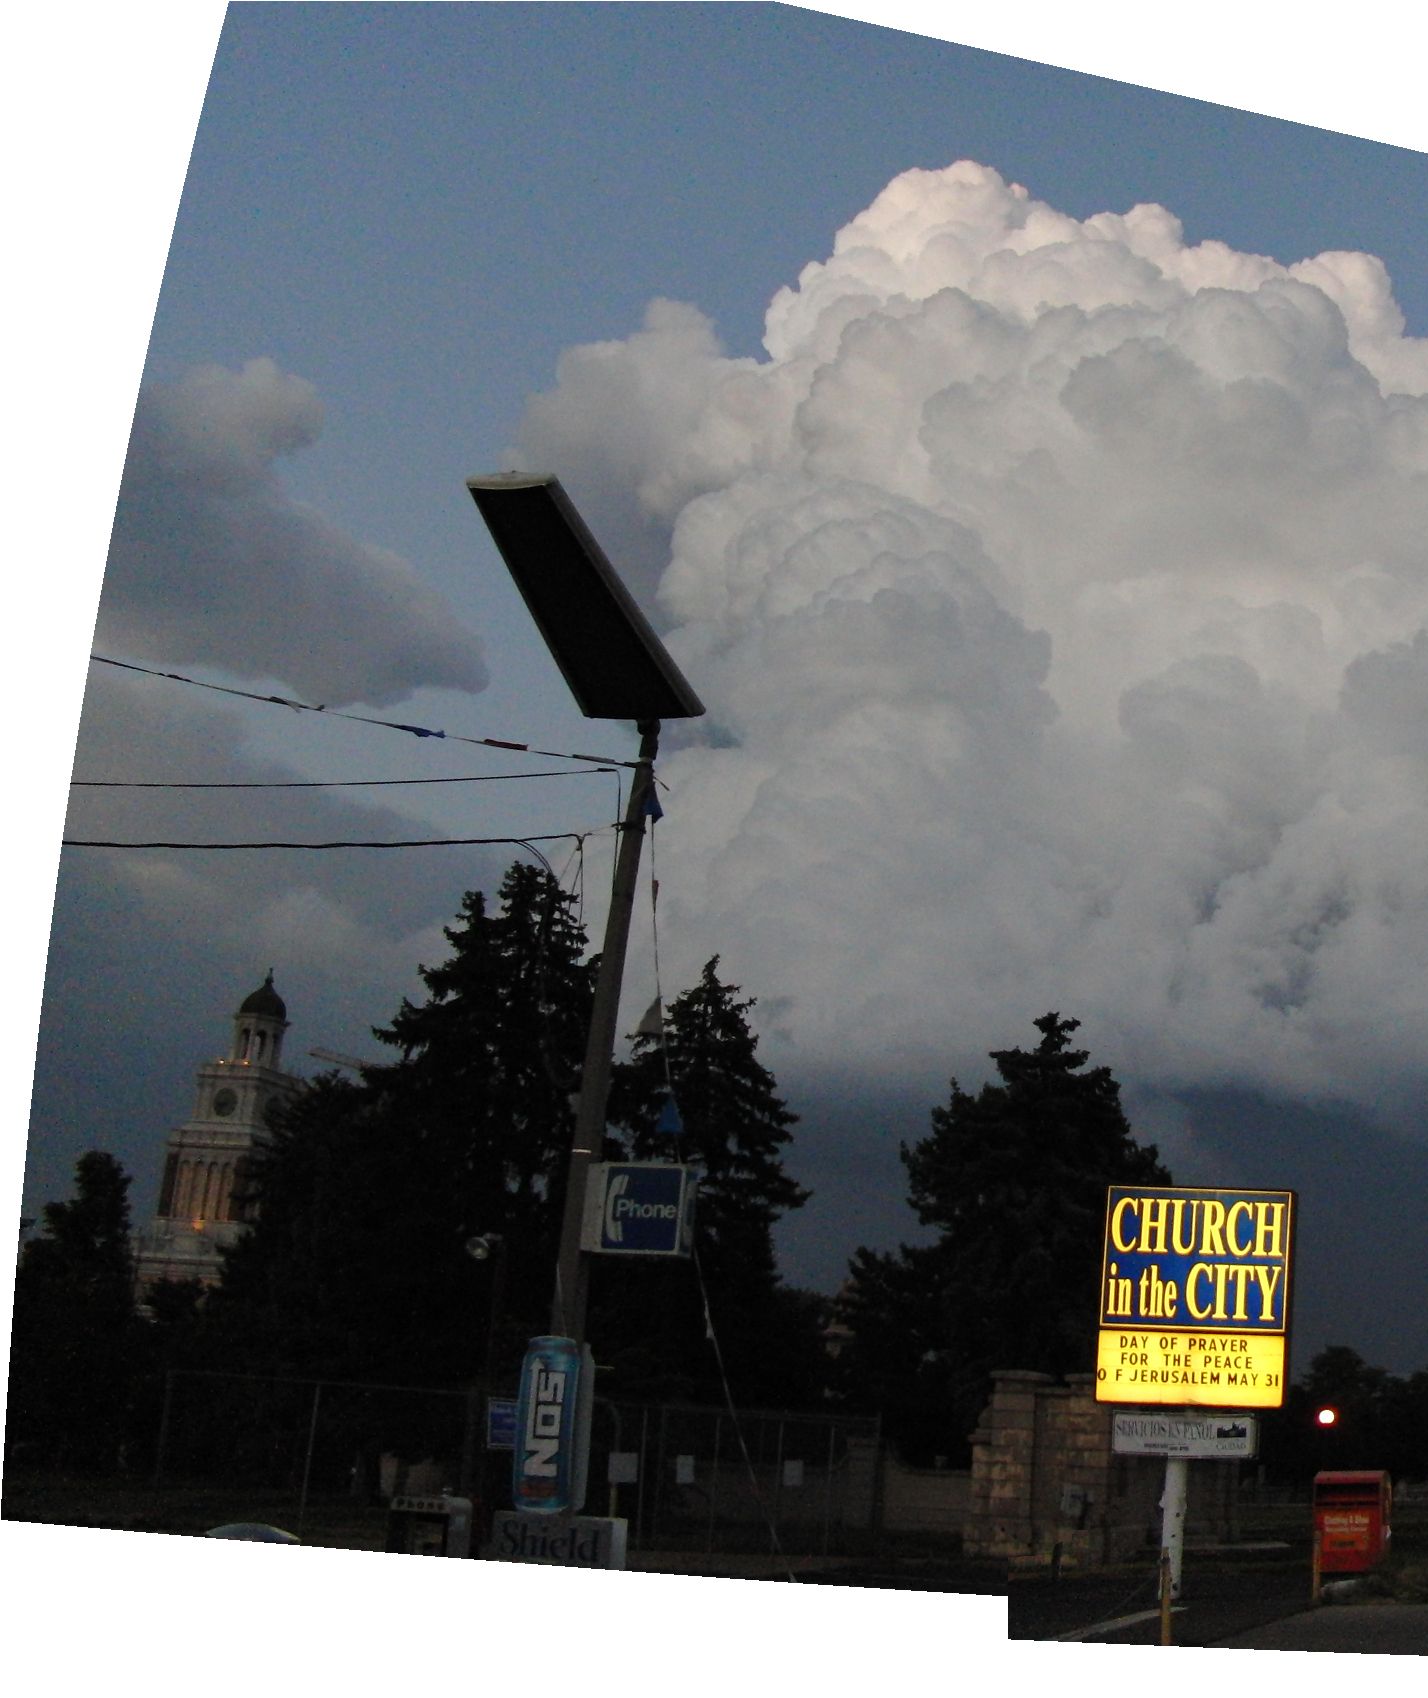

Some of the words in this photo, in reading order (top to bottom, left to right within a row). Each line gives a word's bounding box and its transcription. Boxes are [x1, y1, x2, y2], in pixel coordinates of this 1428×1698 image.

[615, 1198, 678, 1219] Phone
[1111, 1197, 1285, 1257] CHURCH
[1107, 1262, 1132, 1315] in
[1139, 1264, 1177, 1318] the
[1186, 1262, 1282, 1321] CITY
[1119, 1335, 1149, 1349] DAY
[1159, 1337, 1178, 1350] OF
[1188, 1338, 1248, 1353] PRAYER
[1120, 1352, 1149, 1366] FOR
[1163, 1354, 1192, 1368] THE
[1203, 1356, 1253, 1370] PEACE
[1129, 1369, 1220, 1385] JERUSALEM
[1227, 1373, 1259, 1387] MAY
[1265, 1374, 1280, 1388] 31
[523, 1358, 566, 1477] NOS
[502, 1517, 600, 1562] Shield
